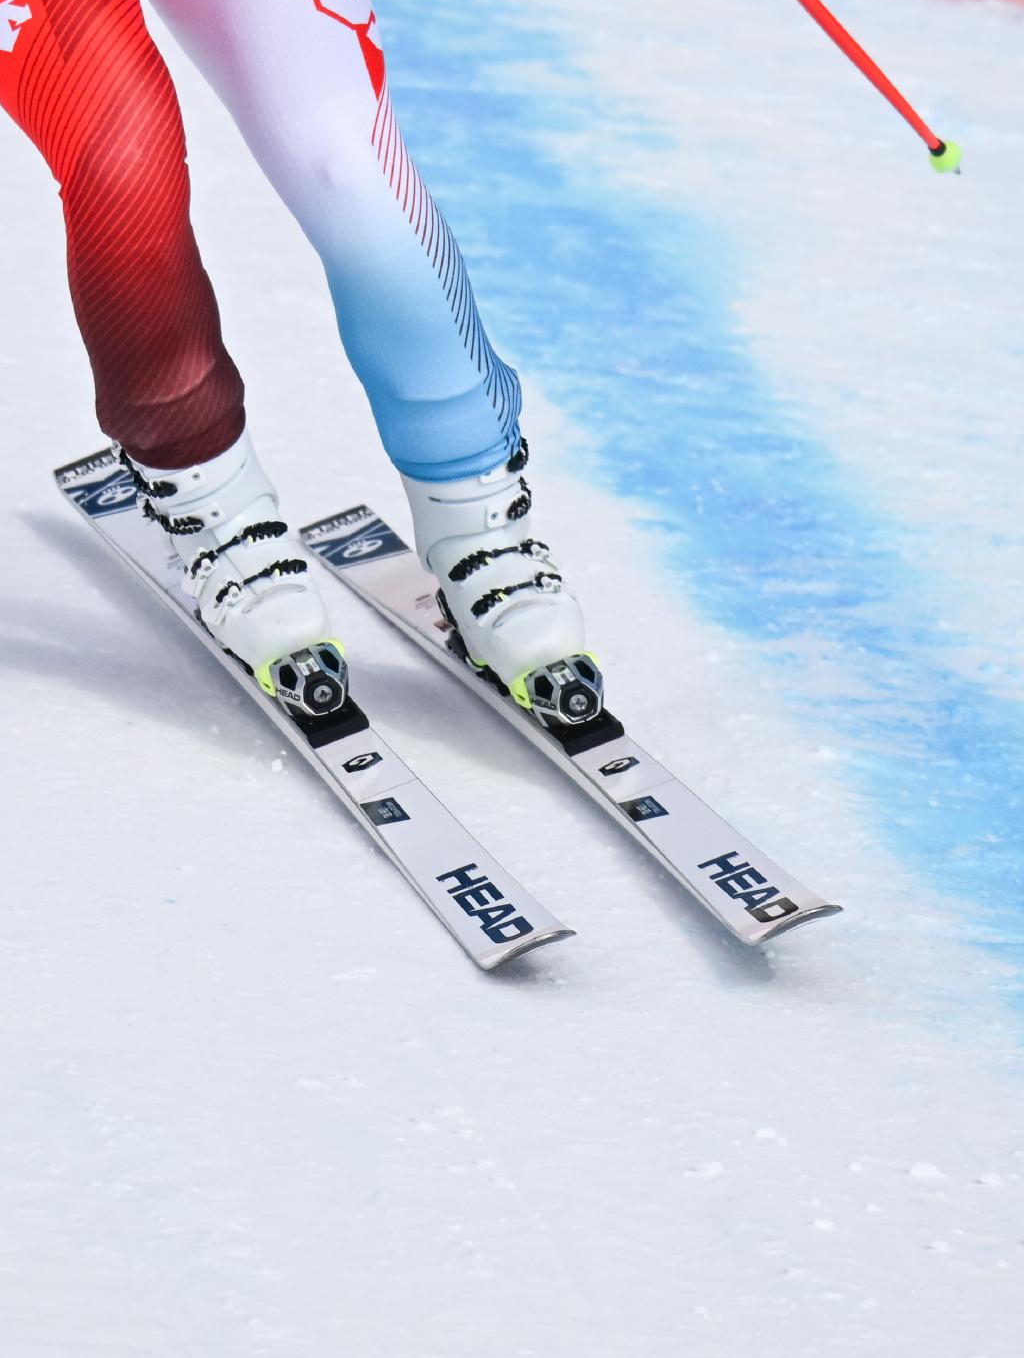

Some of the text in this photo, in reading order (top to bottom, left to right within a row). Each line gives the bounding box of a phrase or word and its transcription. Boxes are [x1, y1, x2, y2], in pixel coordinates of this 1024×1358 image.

[276, 688, 301, 702] HEAD
[531, 698, 557, 711] HEAD
[435, 862, 535, 944] HEAD
[696, 851, 800, 923] HEAD
